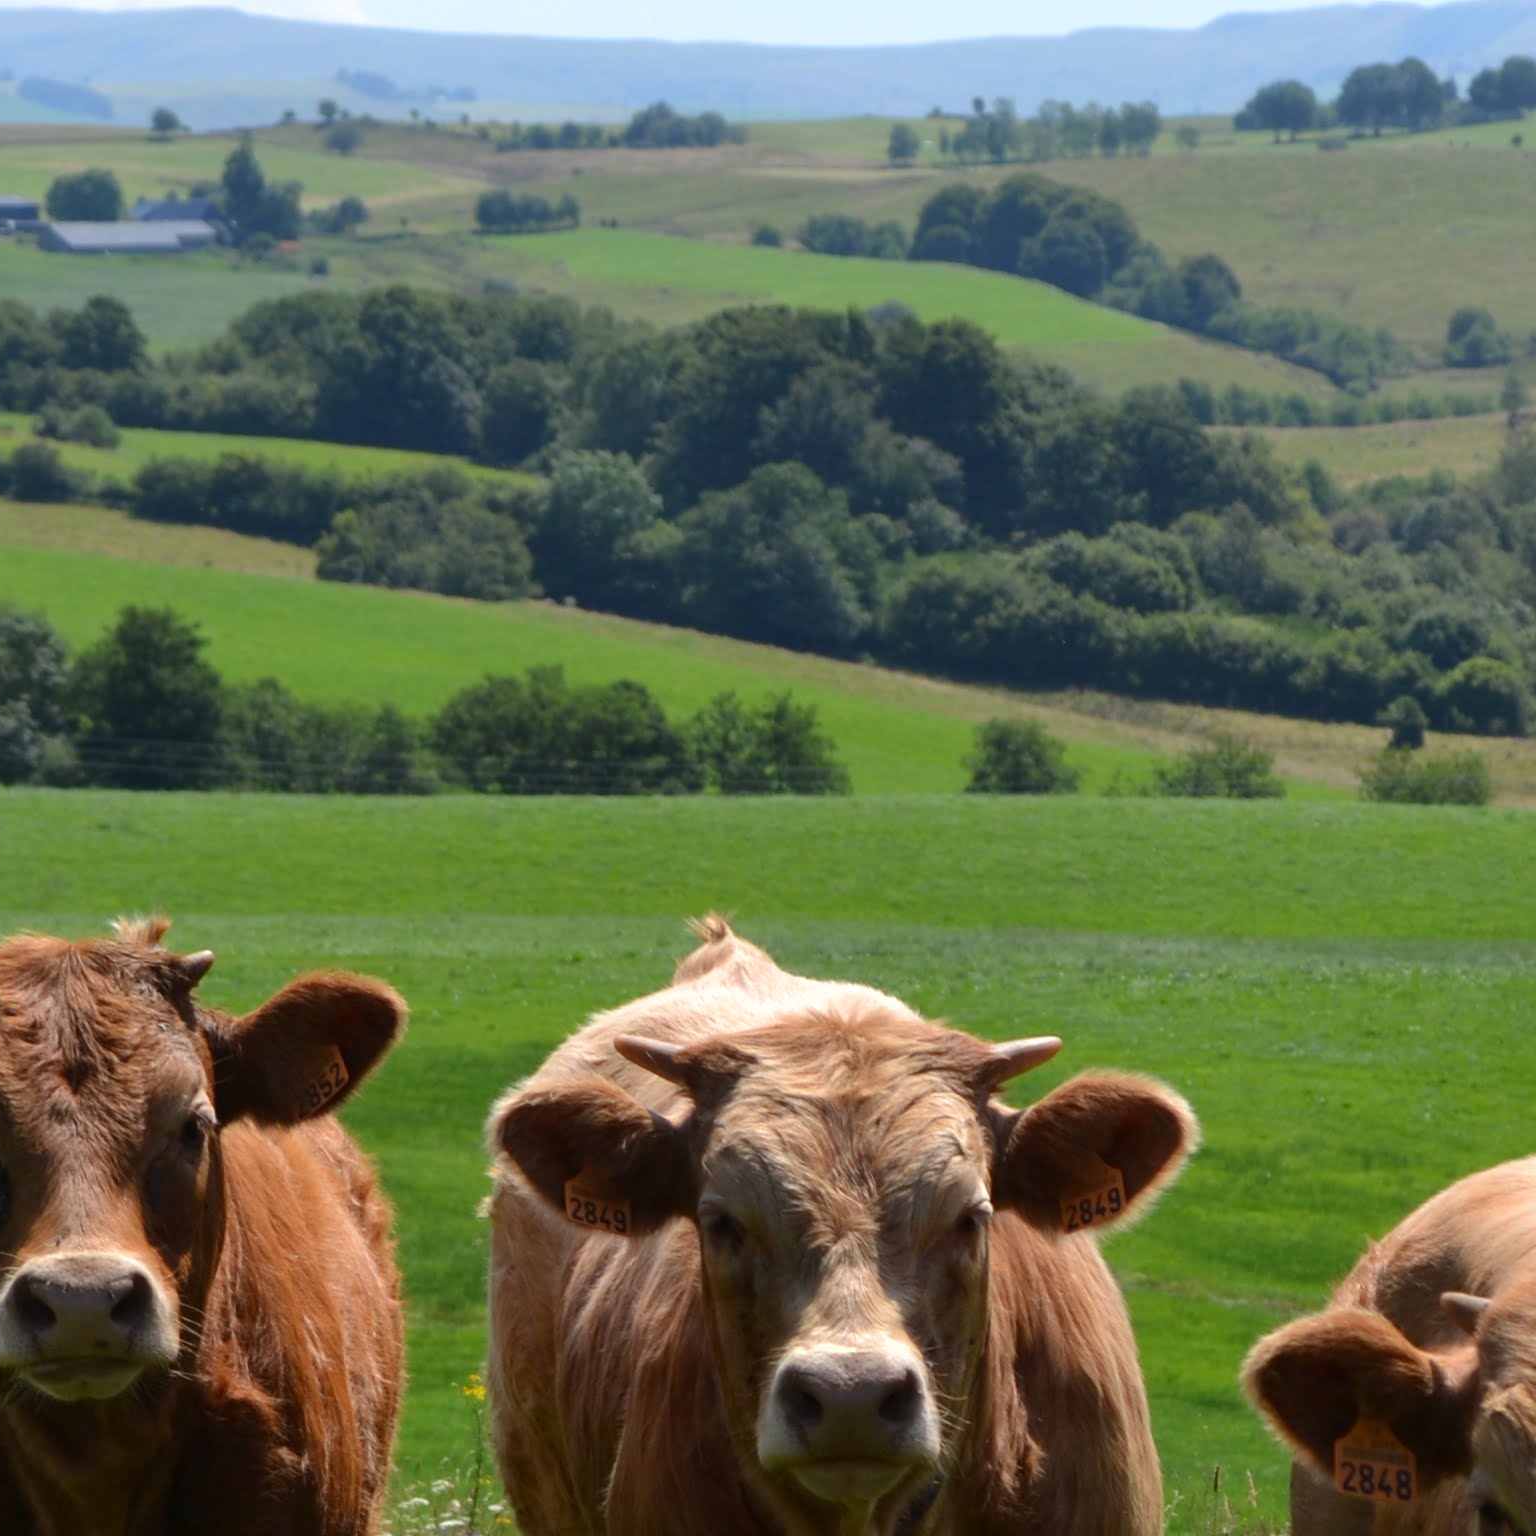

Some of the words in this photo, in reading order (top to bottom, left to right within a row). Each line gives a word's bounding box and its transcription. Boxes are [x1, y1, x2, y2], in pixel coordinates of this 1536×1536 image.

[570, 1197, 627, 1233] 2849
[1065, 1187, 1121, 1230] 2849
[1341, 1461, 1412, 1501] 2848
